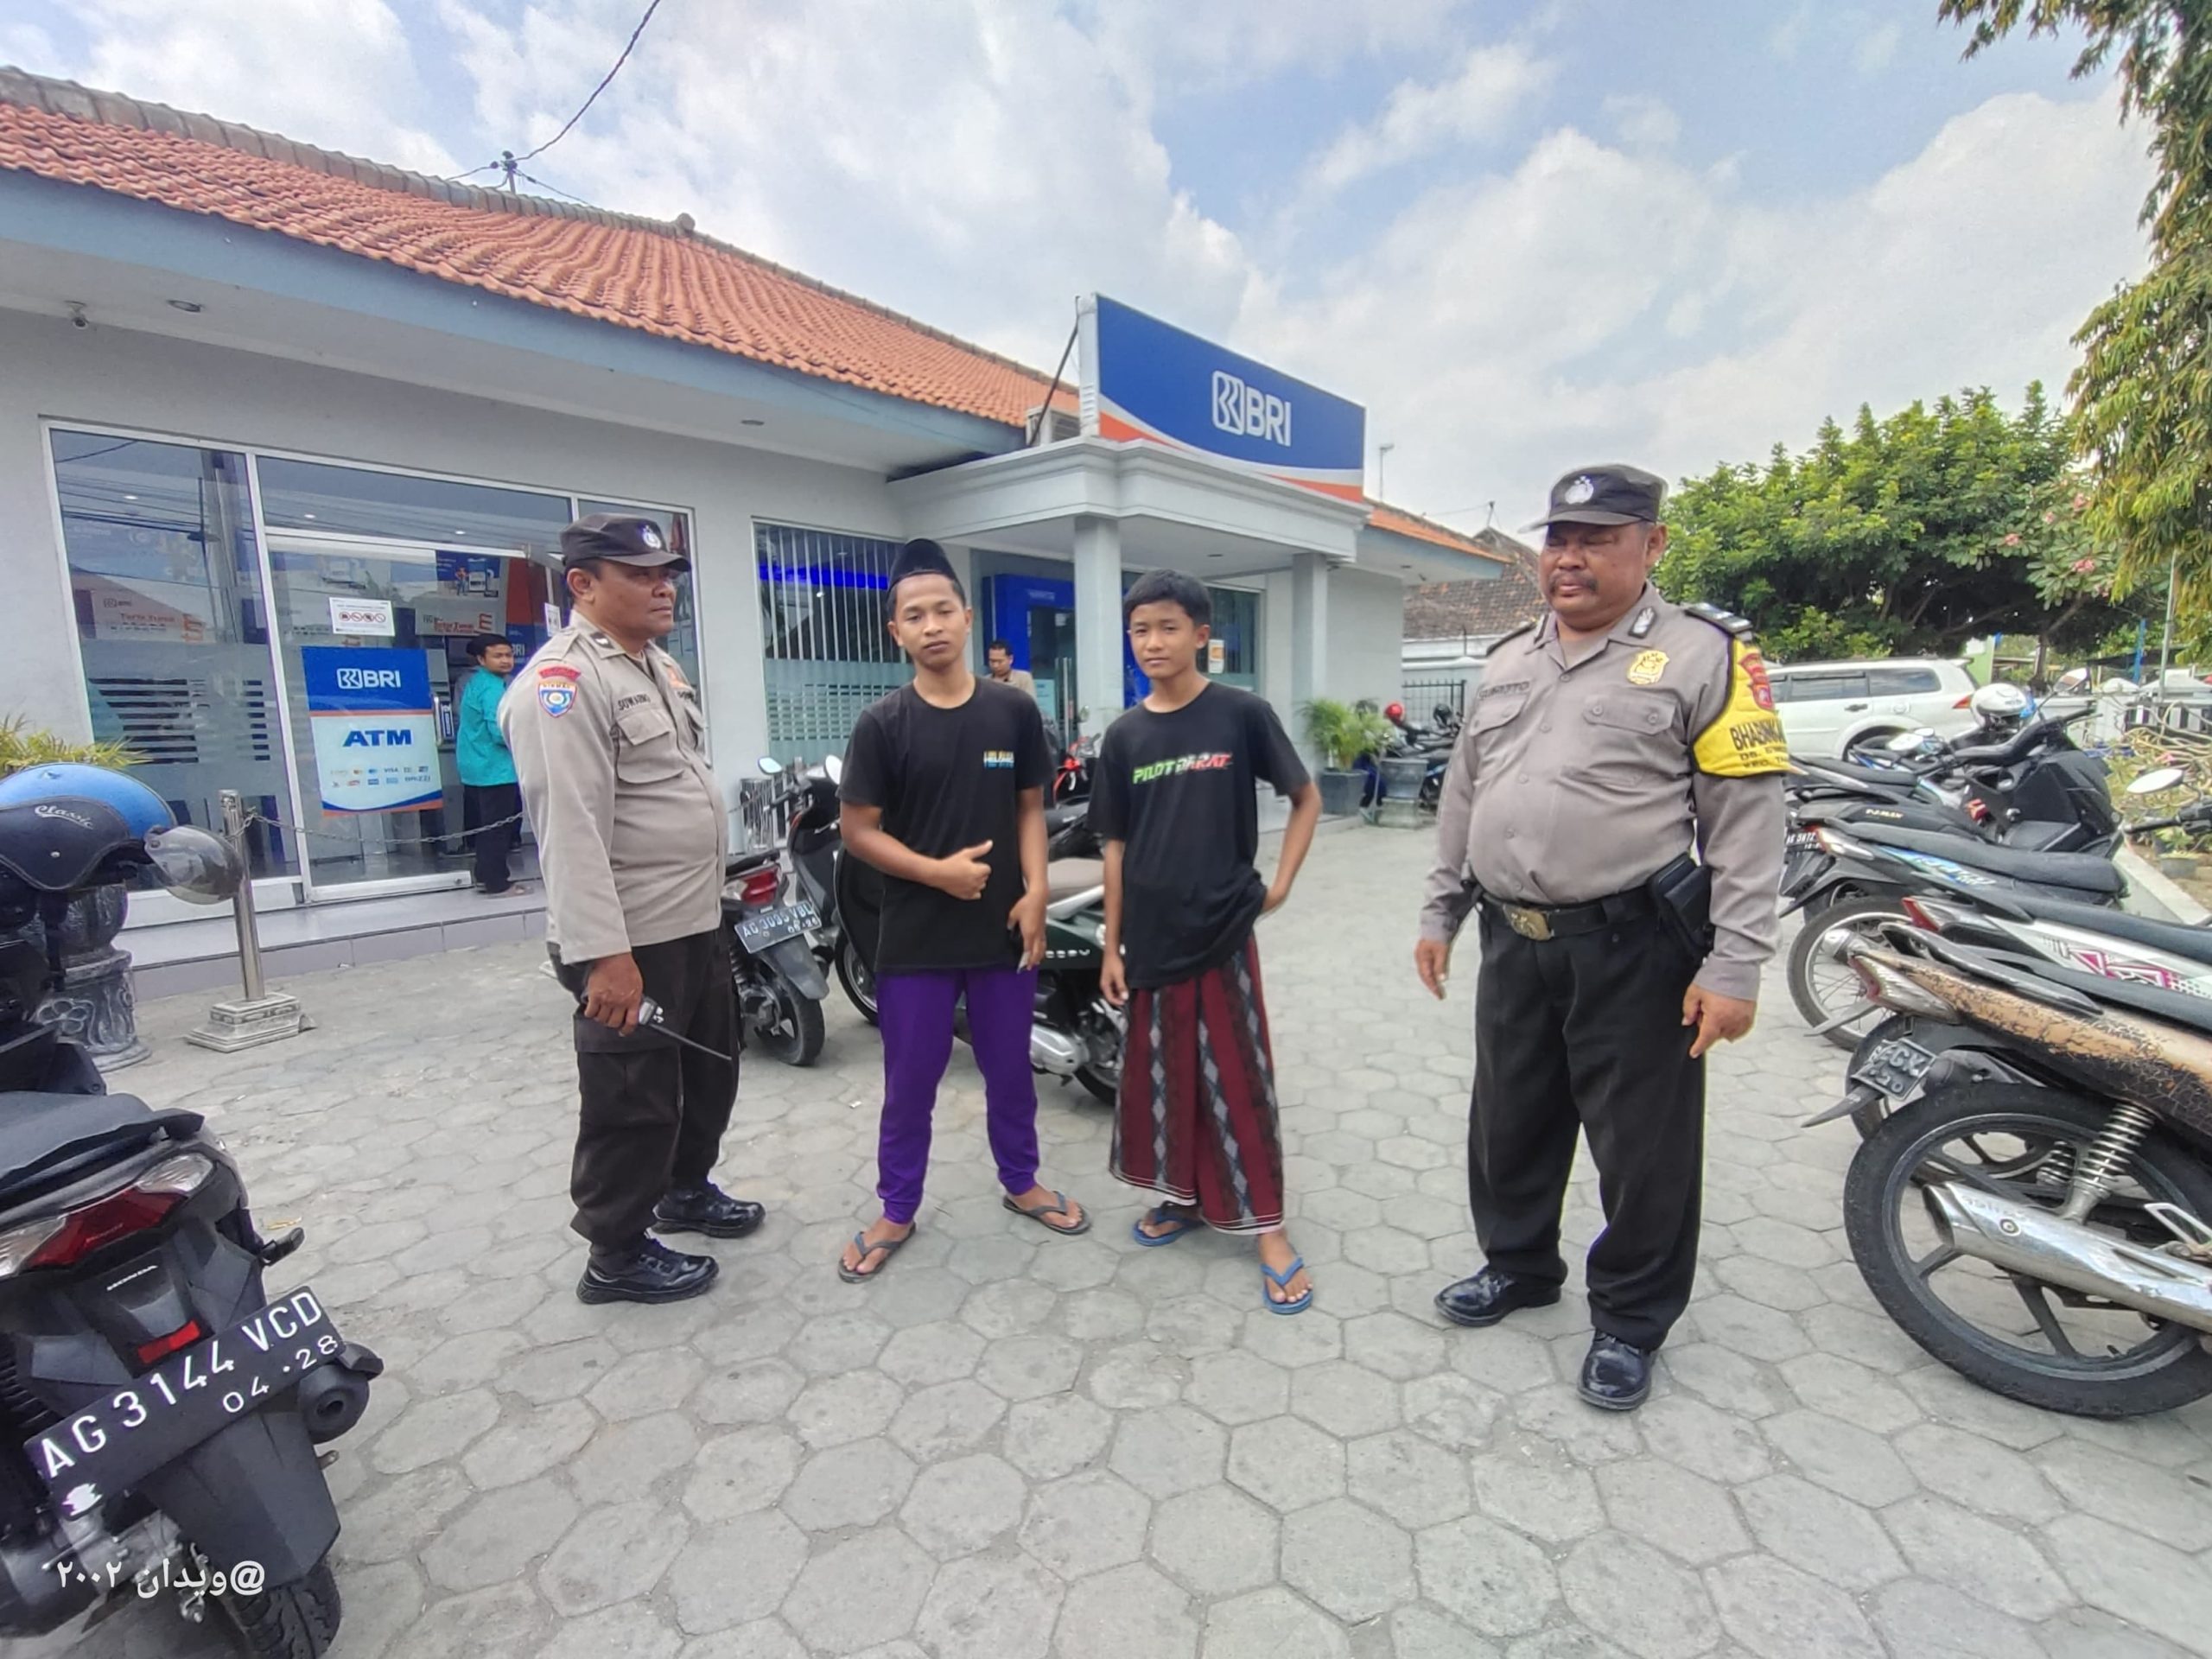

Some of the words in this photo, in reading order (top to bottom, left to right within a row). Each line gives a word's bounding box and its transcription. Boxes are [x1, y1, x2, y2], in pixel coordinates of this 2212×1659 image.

[1246, 386, 1291, 447] BRI
[362, 669, 402, 689] BRI
[342, 728, 412, 747] ATM
[1133, 760, 1176, 784] PILOT
[35, 804, 94, 830] Classic
[41, 1414, 107, 1478] AG
[112, 1340, 234, 1427] 3144
[241, 1292, 322, 1352] VCD
